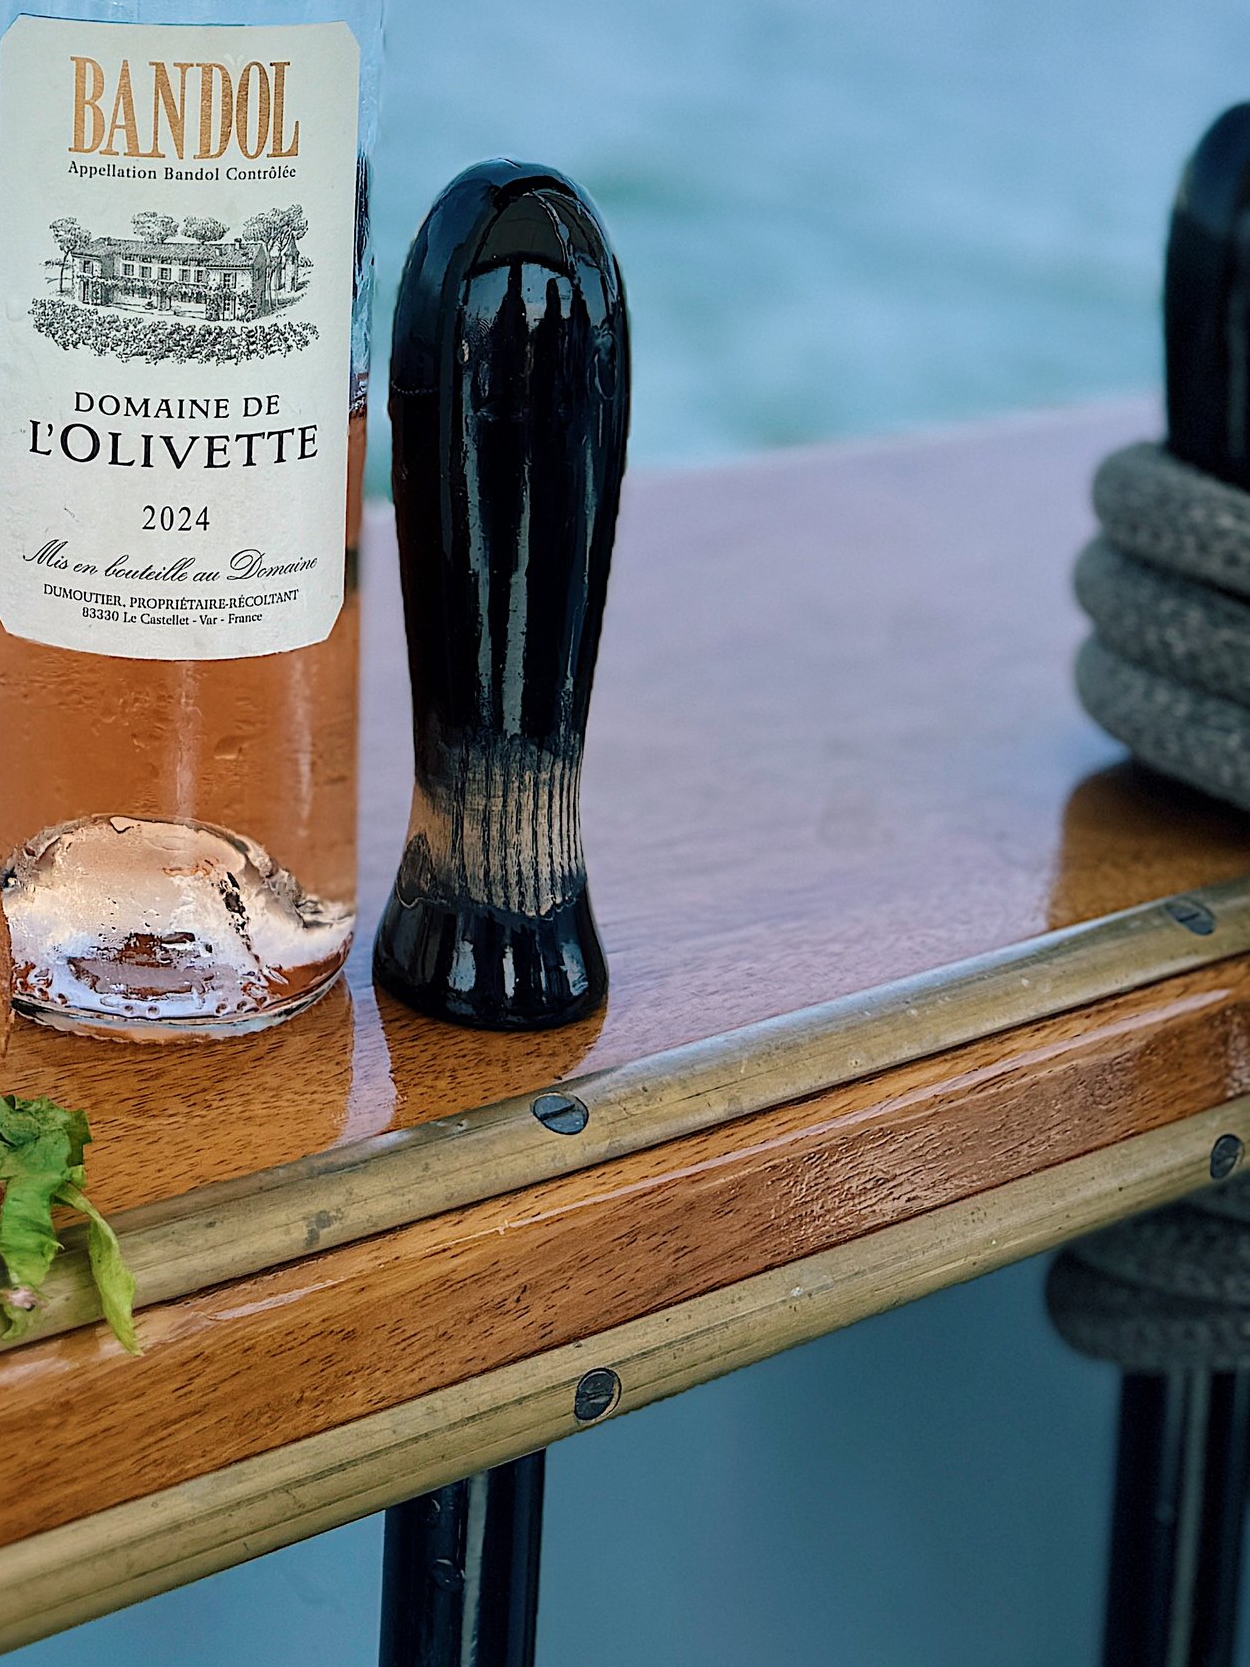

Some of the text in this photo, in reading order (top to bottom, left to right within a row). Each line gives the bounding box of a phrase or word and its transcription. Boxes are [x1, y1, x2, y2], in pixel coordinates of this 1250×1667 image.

[68, 56, 299, 160] BANDOL
[68, 160, 296, 181] Appellation Bandol Contrôlée
[74, 391, 280, 419] DOMAINE DE
[29, 419, 318, 470] L'OLIVETTE
[142, 505, 210, 532] 2024
[22, 538, 318, 582] Mis en bouteille au Domaine
[129, 589, 299, 610] PROPRIÉTAIRE-RÉCOLTANT
[82, 607, 119, 622] 83330
[123, 612, 137, 624] Le
[140, 613, 189, 626] Castellet
[199, 614, 218, 625] Var
[228, 613, 263, 625] France
